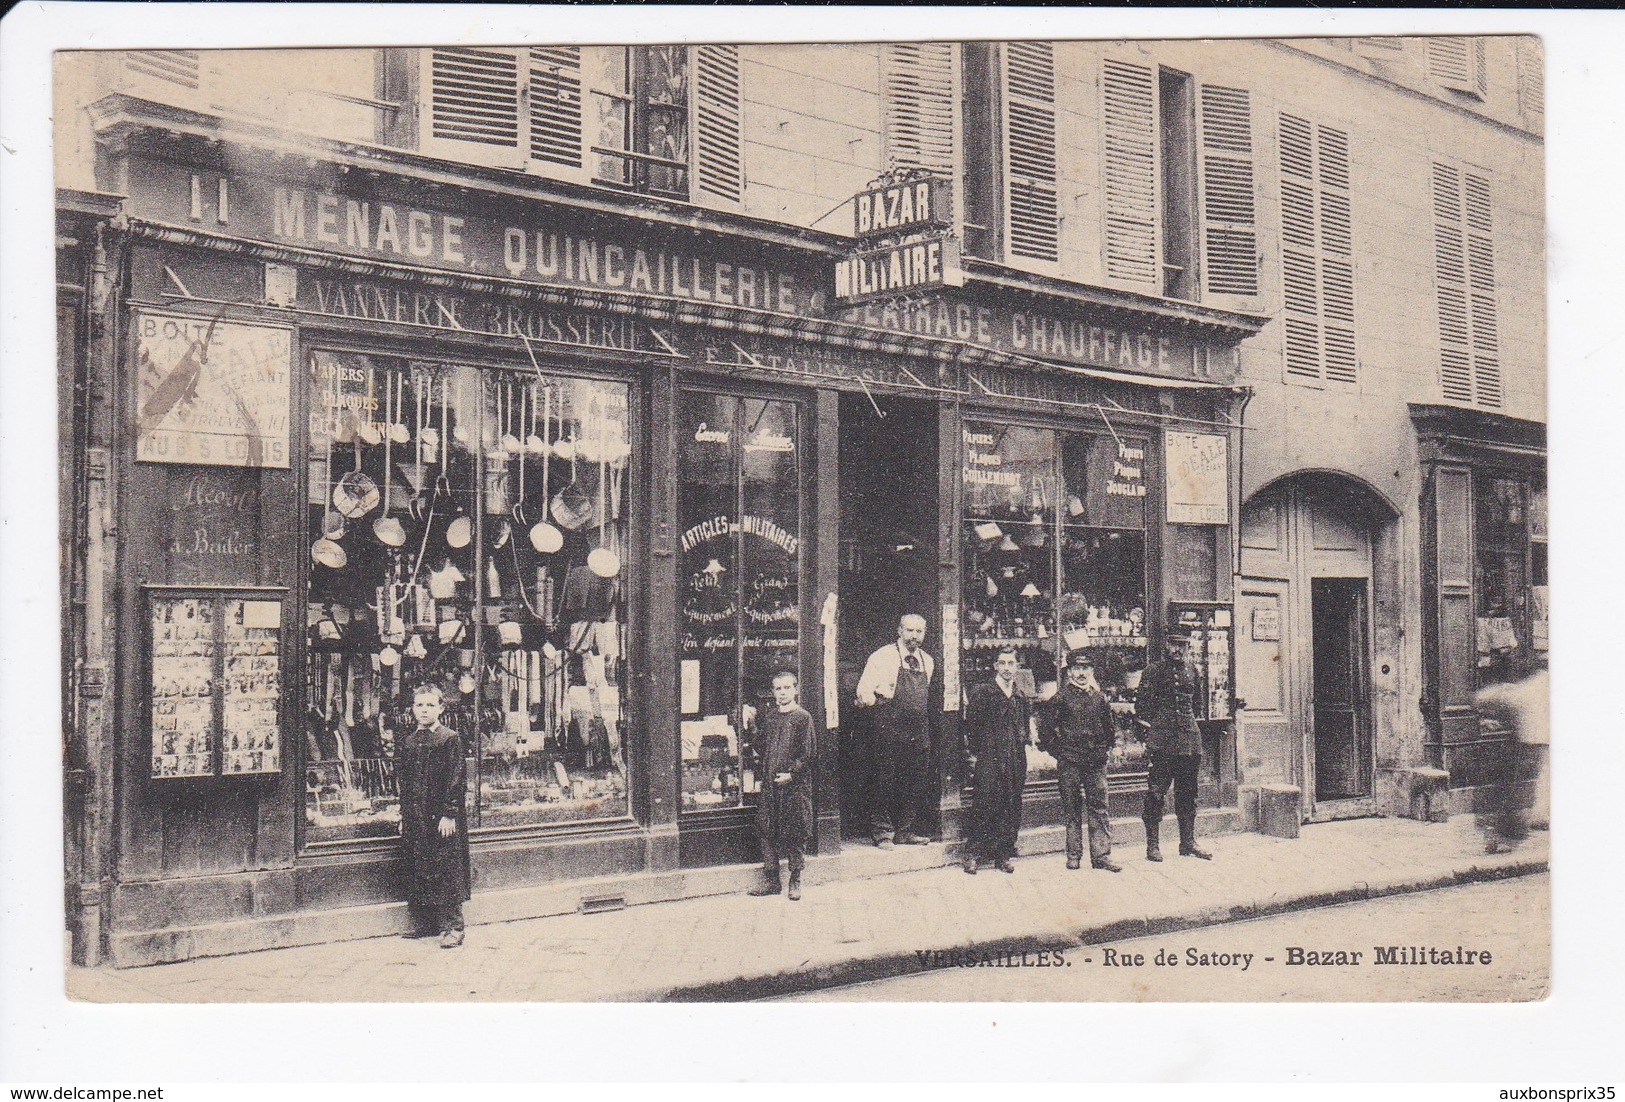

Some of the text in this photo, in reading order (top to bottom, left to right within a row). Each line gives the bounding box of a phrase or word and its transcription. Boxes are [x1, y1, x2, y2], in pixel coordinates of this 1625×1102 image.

[859, 182, 929, 232] BAZAR
[835, 242, 940, 298] MILITAIRE
[1011, 312, 1171, 371] CHAUFFAGE
[223, 439, 284, 462] LOIS
[681, 515, 729, 552] ARTICLES
[743, 515, 798, 554] MILITAIRES
